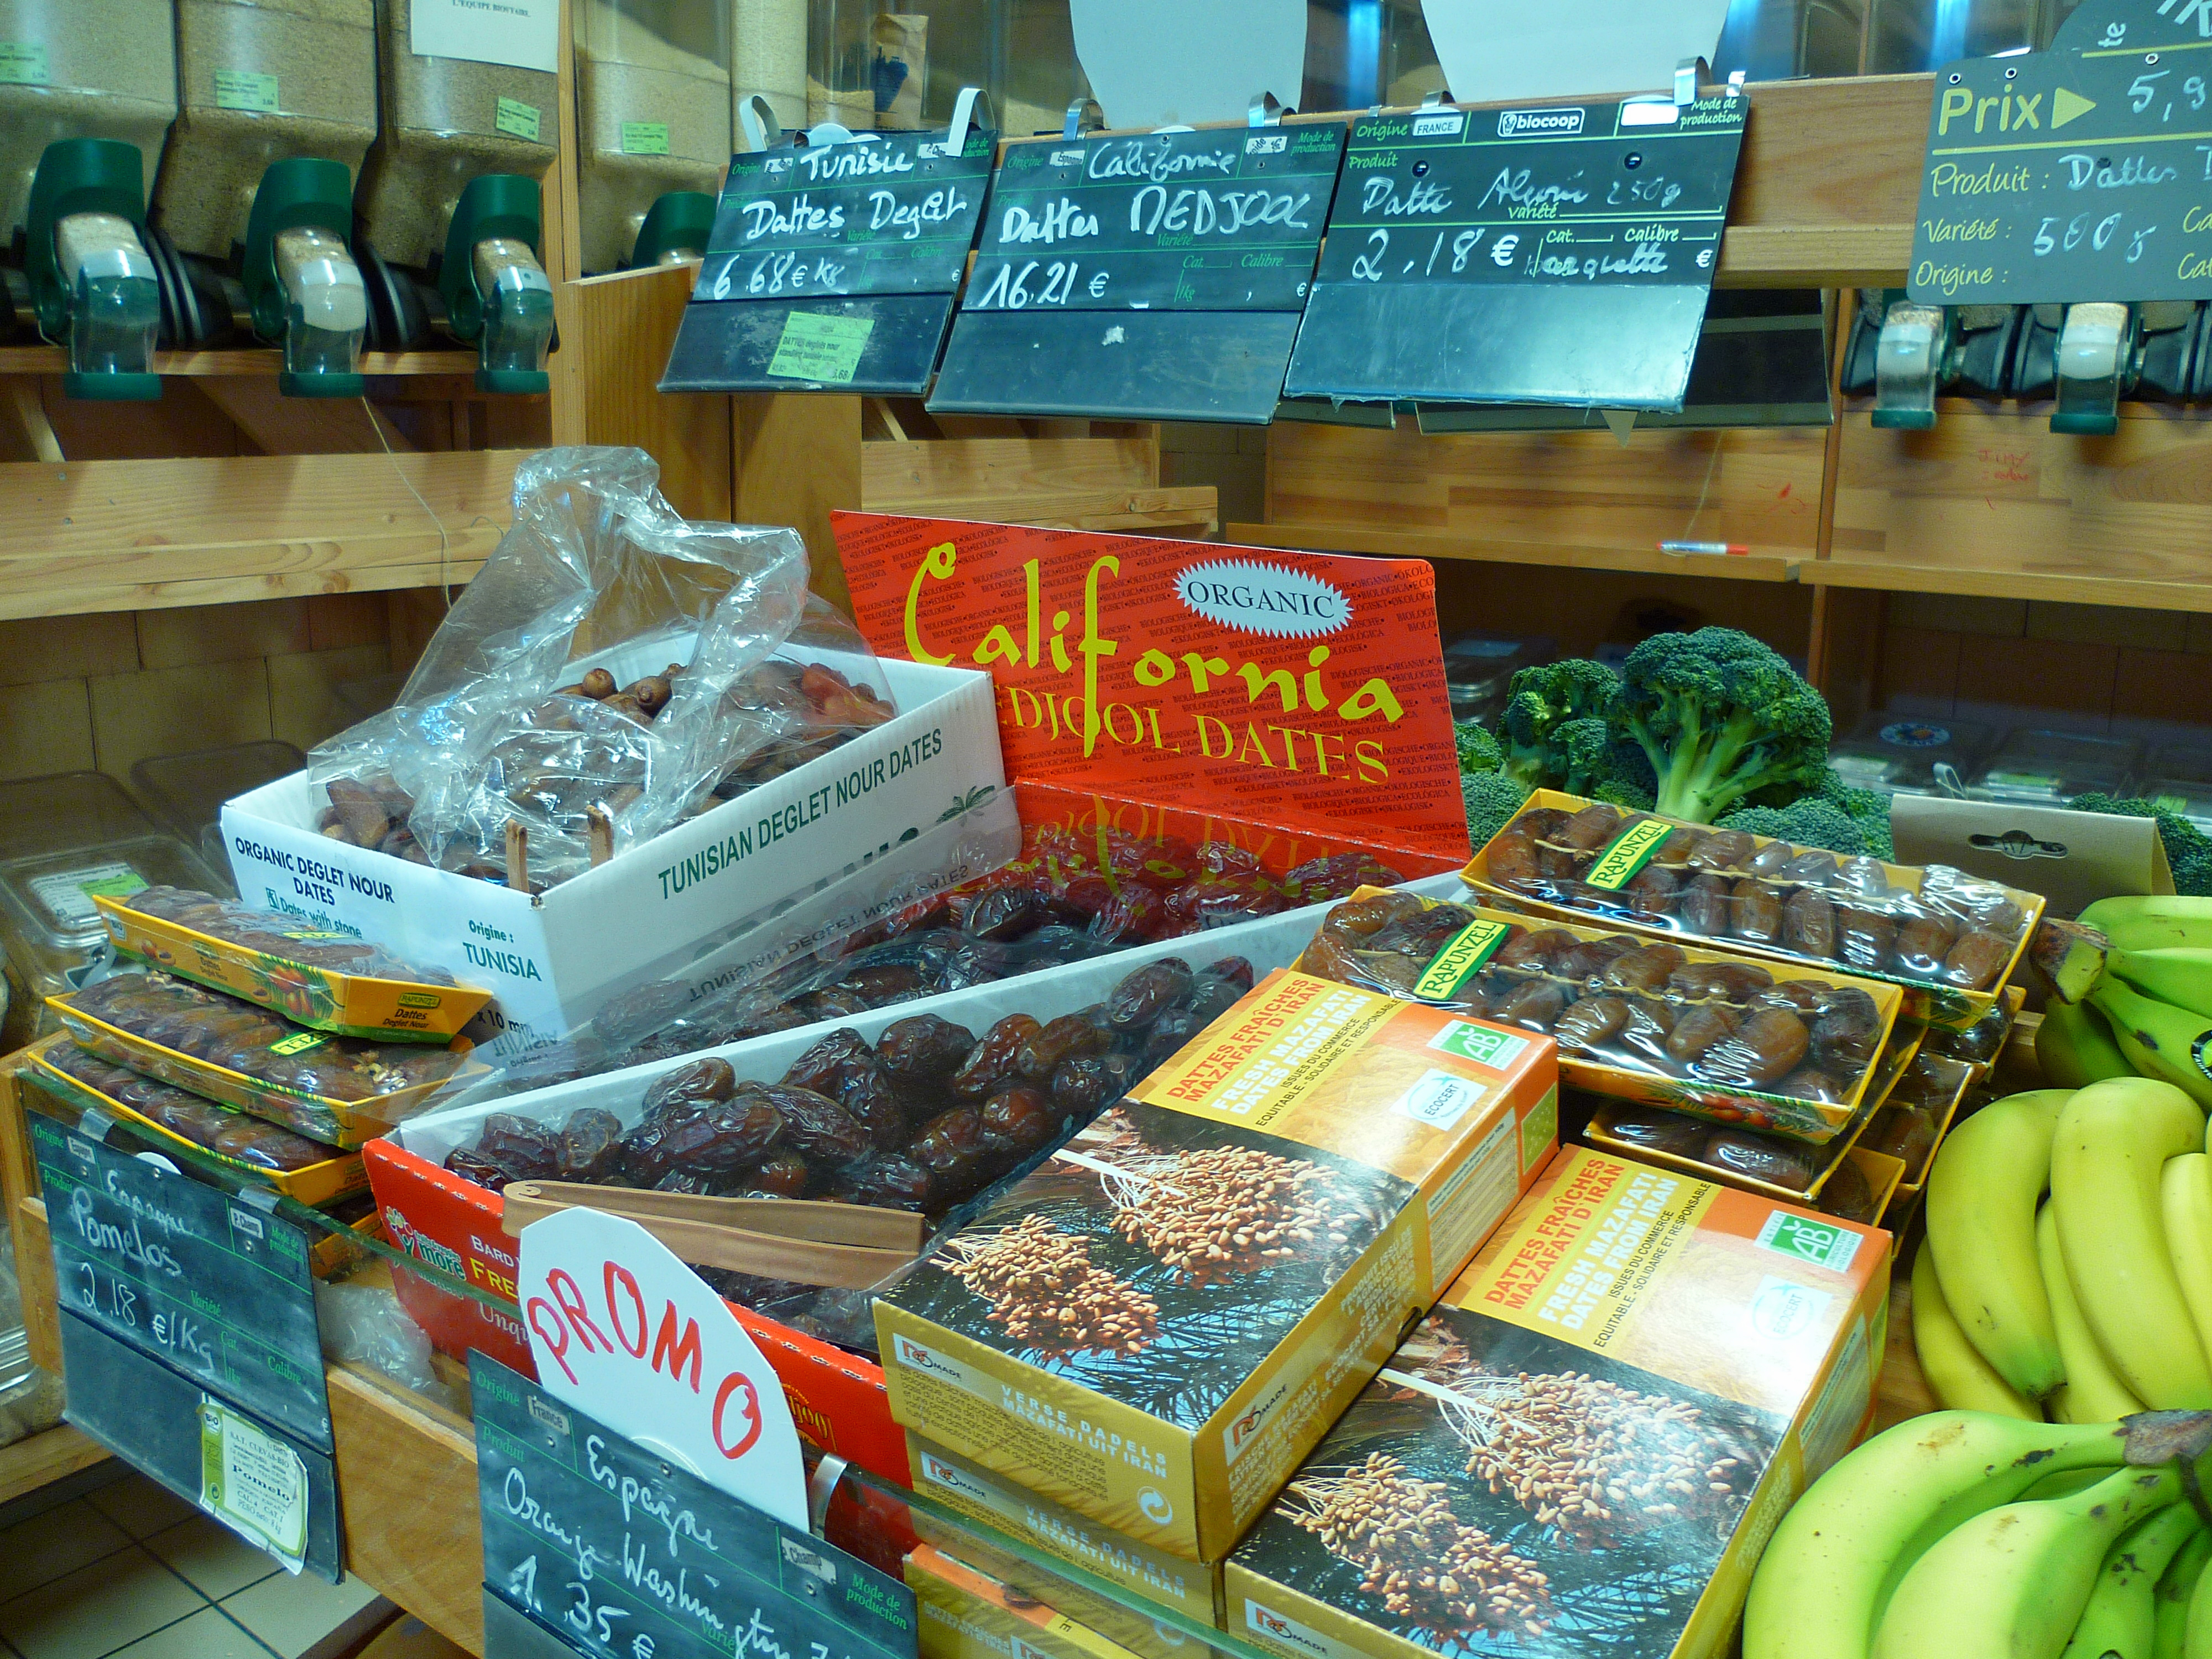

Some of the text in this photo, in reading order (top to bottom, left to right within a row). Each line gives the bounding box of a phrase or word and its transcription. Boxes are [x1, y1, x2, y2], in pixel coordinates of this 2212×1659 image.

[1516, 112, 1580, 132] biocoop
[1679, 111, 1743, 131] production
[1691, 97, 1737, 111] Mode de
[1938, 84, 2042, 135] Prix
[1298, 131, 1334, 143] Mode de
[1357, 122, 1408, 139] Origine
[1417, 121, 1454, 134] FRANCE
[1007, 155, 1044, 170] Origine
[1290, 143, 1335, 156] production
[1349, 153, 1399, 169] Produit
[1931, 163, 2031, 197] Produit
[1157, 233, 1194, 247] Variété
[1923, 217, 1999, 243] Variété
[1241, 253, 1284, 268] Calibre
[1491, 235, 1520, 267] €
[1695, 249, 1713, 268] €
[791, 265, 808, 288] €
[1089, 273, 1109, 299] €
[1915, 260, 1993, 296] Origine
[1187, 581, 1334, 618] ORGANIC
[905, 542, 1404, 758] California
[1191, 713, 1389, 784] DATES
[659, 728, 942, 899] TUNISIAN DEGLET NOUR DATES
[235, 837, 395, 904] ORGANIC DEGLET NOUR
[1594, 823, 1663, 884] RAPUNZEL
[293, 877, 336, 906] DATES
[309, 909, 332, 930] with
[468, 919, 507, 943] Origine
[463, 942, 542, 982] TUNISIA
[1423, 922, 1496, 993] RAPUNZEL
[383, 1018, 429, 1029] Deglet Nour
[394, 1007, 427, 1020] Dattes
[488, 1009, 505, 1029] 10
[1166, 979, 1309, 1098] DATTES FRAÎCHES
[1211, 989, 1354, 1111] FRESH MAZAFATI
[1229, 994, 1372, 1115] DATES FROM IRAN
[1281, 1018, 1361, 1089] ISSUES DU COMMERCE
[1463, 1031, 1502, 1061] AB
[1183, 1029, 1275, 1102] MAZAFATI
[1255, 1084, 1306, 1127] EQUITABLE
[1306, 1046, 1346, 1082] SOLIDAIRE
[1341, 1037, 1355, 1053] ET
[1352, 999, 1403, 1040] RESPONSABLE
[1424, 1083, 1460, 1117] ECOCERT
[1484, 1158, 1606, 1304] DATTES FRAÎCHES
[1537, 1172, 1658, 1322] FRESH MAZAFATI
[1792, 1227, 1834, 1262] AB
[417, 1240, 467, 1281] more
[471, 1234, 514, 1267] BARD
[1503, 1222, 1582, 1311] MAZAFATI
[1560, 1177, 1679, 1331] DATES FROM IRAN
[1593, 1182, 1712, 1348] EQUITABLE SOLIDAIRE ET RESPONSABLE
[1608, 1209, 1675, 1300] ISSUES DU COMMERCE
[470, 1256, 519, 1299] FRE
[1773, 1293, 1803, 1334] ECOCERT
[266, 1357, 302, 1386] Calibre
[526, 1260, 763, 1460] PROMO
[477, 1371, 520, 1407] Origine
[1001, 1384, 1167, 1465] VERSE DADELS
[1003, 1398, 1167, 1479] MAZAFATI UIT IRAN
[482, 1428, 525, 1463] Produit
[232, 1464, 291, 1503] Pomelo
[852, 1573, 901, 1610] Mode de
[1144, 1570, 1185, 1599] IRAN
[846, 1588, 907, 1630] production
